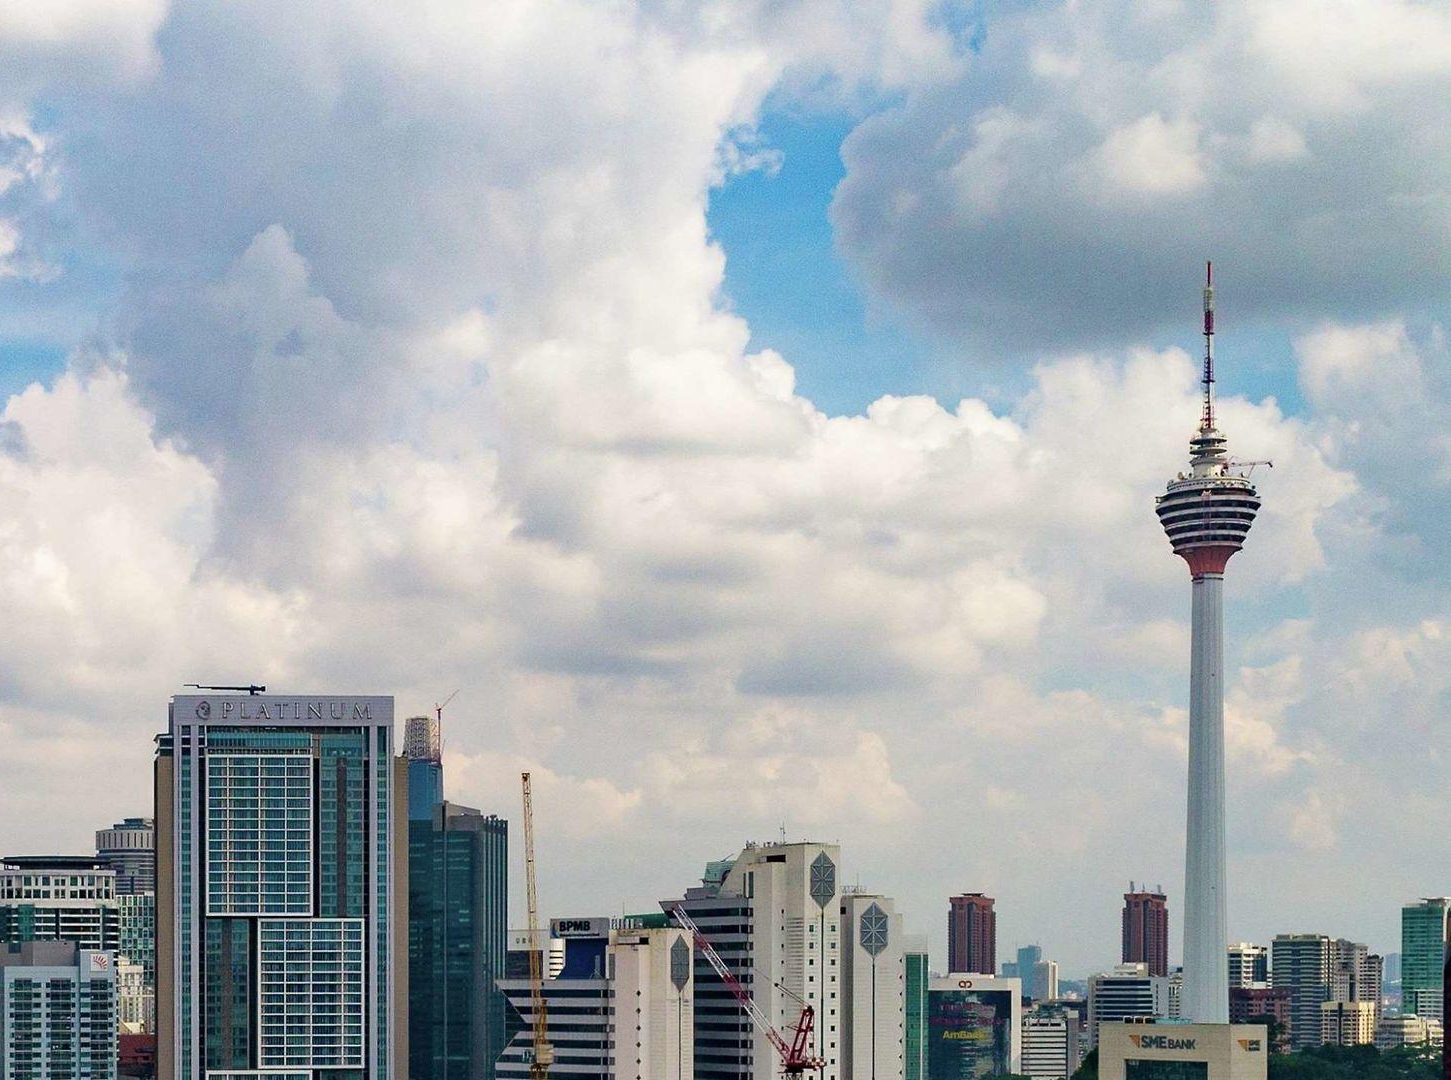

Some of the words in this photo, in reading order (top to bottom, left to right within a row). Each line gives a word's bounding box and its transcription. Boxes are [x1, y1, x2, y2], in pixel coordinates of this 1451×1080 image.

[222, 702, 373, 720] PLATINUM
[559, 921, 590, 932] BPMB
[1141, 1035, 1167, 1049] SME
[1168, 1038, 1196, 1050] BANK
